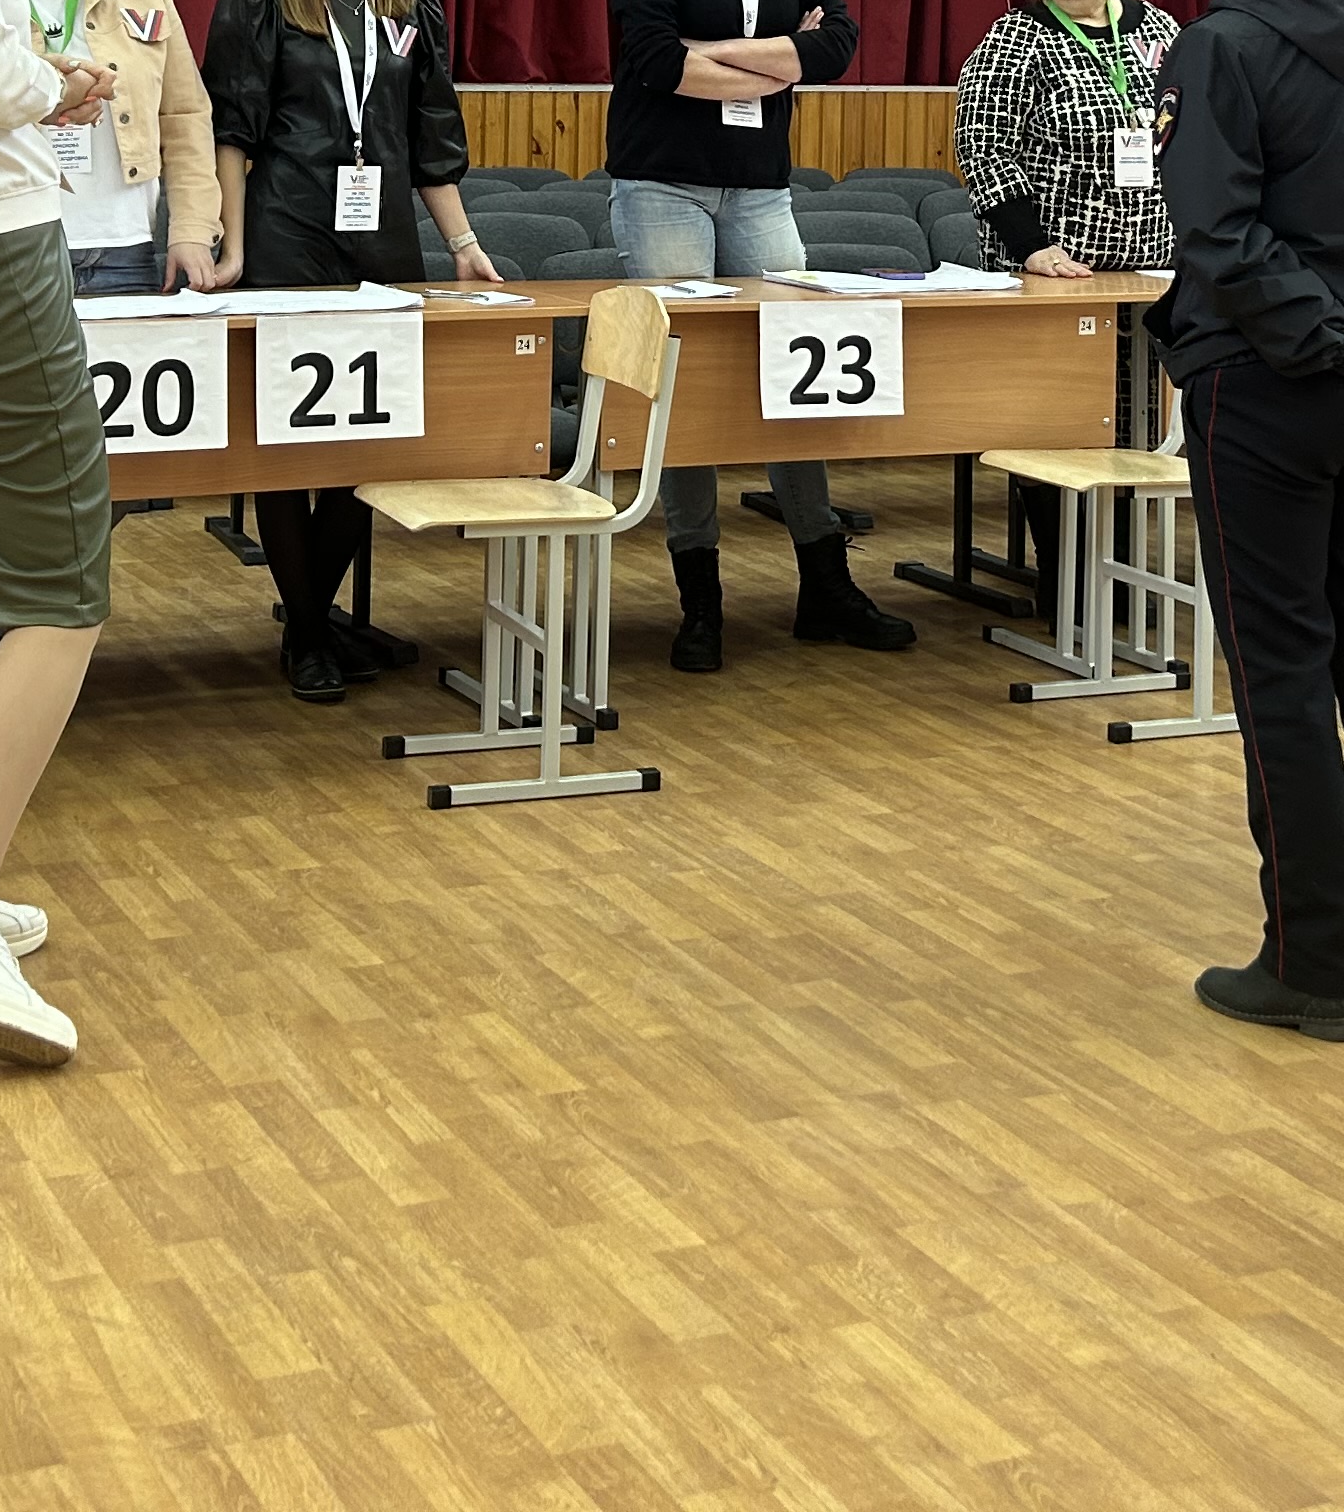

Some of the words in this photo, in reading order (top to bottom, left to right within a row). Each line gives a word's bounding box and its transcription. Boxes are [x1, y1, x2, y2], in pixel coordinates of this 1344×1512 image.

[517, 339, 530, 350] 24
[1081, 320, 1092, 331] 24
[89, 358, 195, 439] 20
[289, 350, 391, 428] 21
[789, 334, 876, 406] 23
